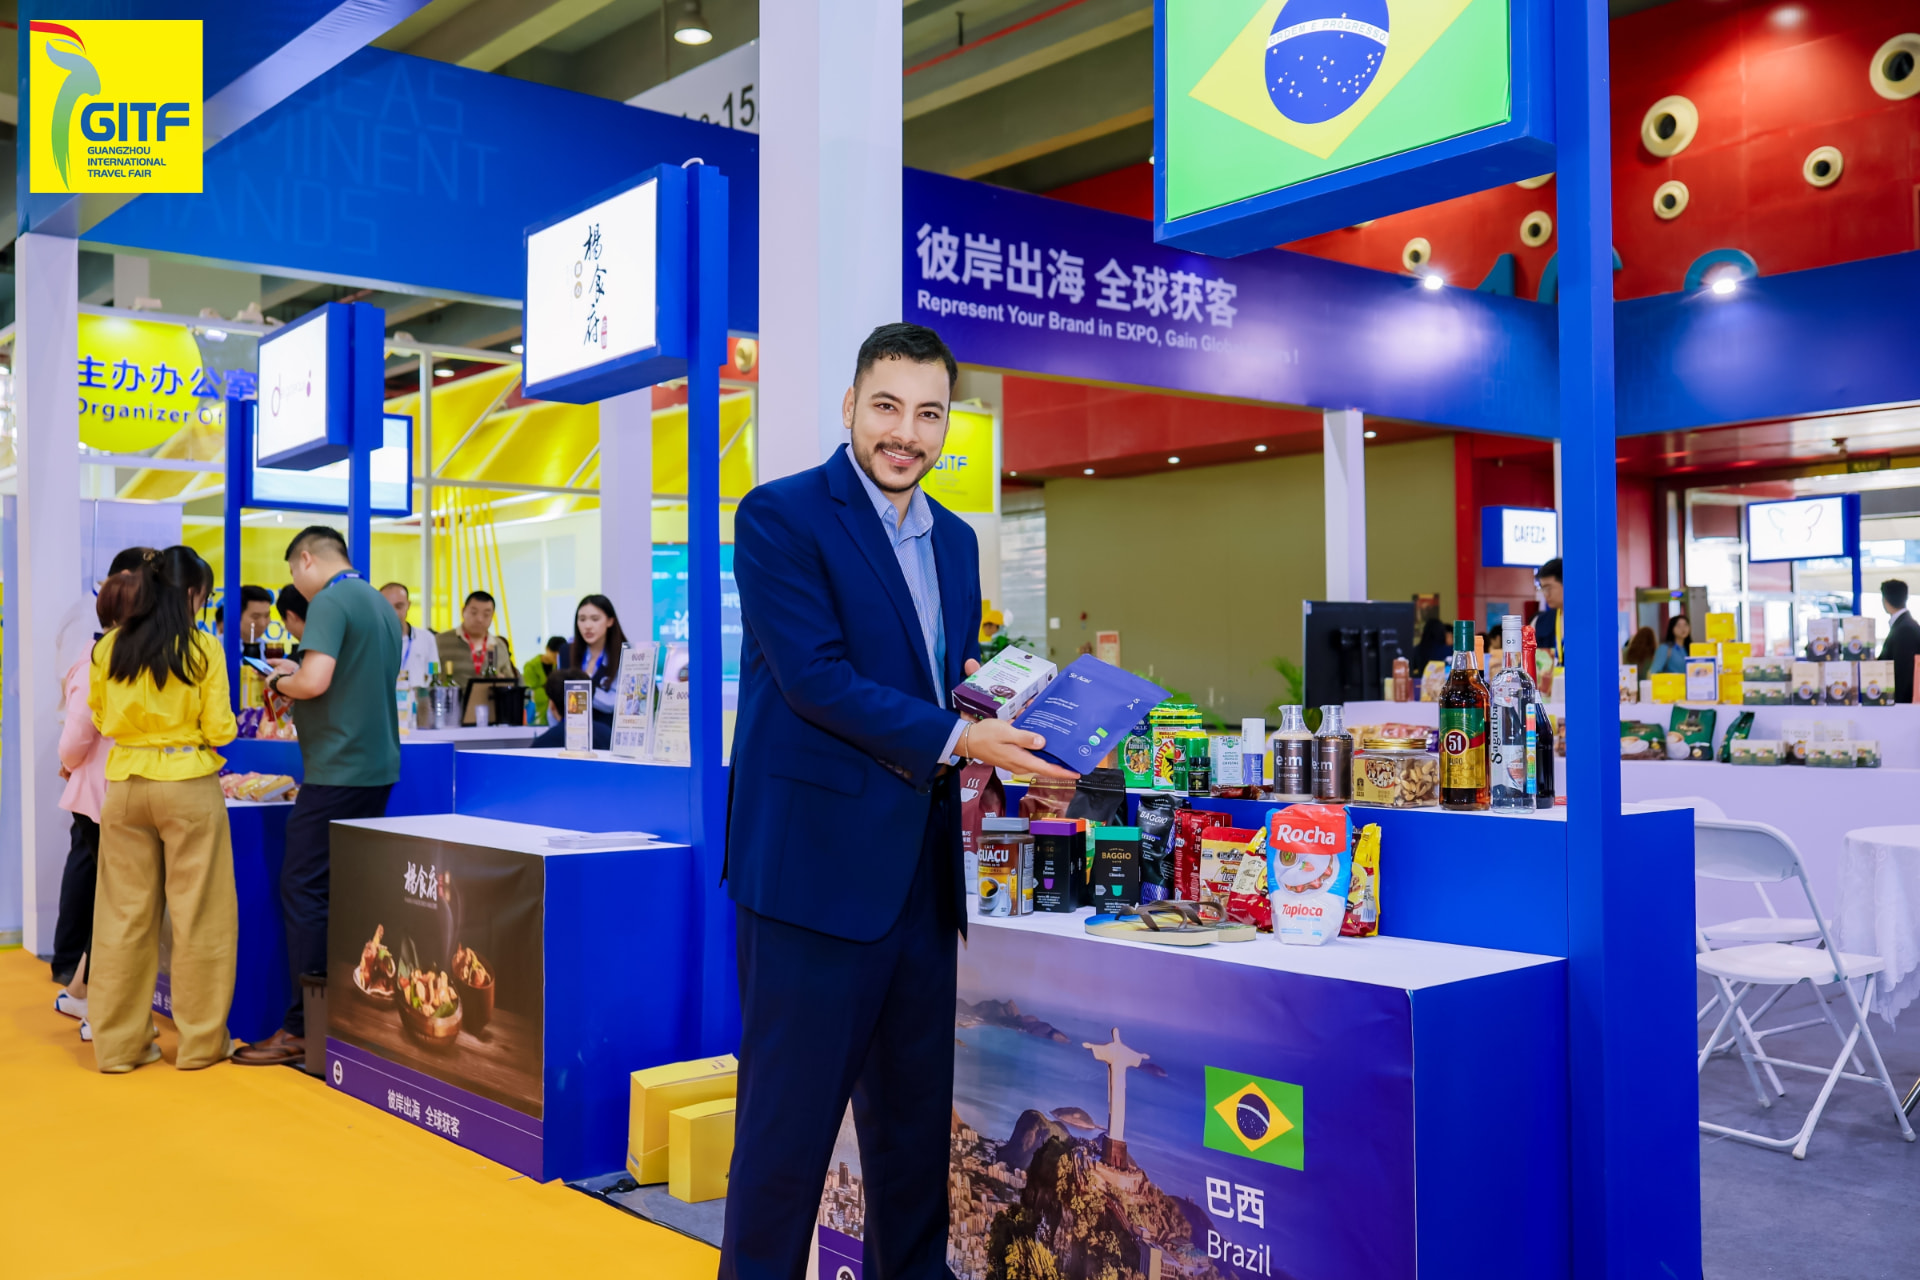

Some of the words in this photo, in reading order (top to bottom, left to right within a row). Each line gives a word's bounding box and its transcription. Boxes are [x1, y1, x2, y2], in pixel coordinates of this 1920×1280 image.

[1322, 20, 1387, 42] PROGRESSO
[916, 222, 1086, 305] 彼岸出海
[1094, 257, 1239, 329] 全球获客
[917, 289, 1004, 323] Represent
[1007, 304, 1045, 329] Your
[1049, 311, 1096, 336] Brand
[1099, 318, 1113, 338] in
[1116, 321, 1163, 348] EXPO,
[1165, 329, 1198, 351] Gain
[78, 354, 257, 402] 主办办公室
[1448, 734, 1462, 751] 51
[1490, 705, 1504, 765] Sagatiba
[1154, 739, 1175, 778] MAZUTTI
[1140, 810, 1168, 825] BAGGIO
[1276, 824, 1336, 846] Rocha
[1101, 852, 1132, 860] BAGGIO
[1281, 903, 1324, 918] Tapioca
[387, 1088, 421, 1122] 彼岸出海
[425, 1104, 460, 1139] 全球获客
[1205, 1176, 1265, 1230] 巴西
[1206, 1229, 1272, 1277] Brazil
